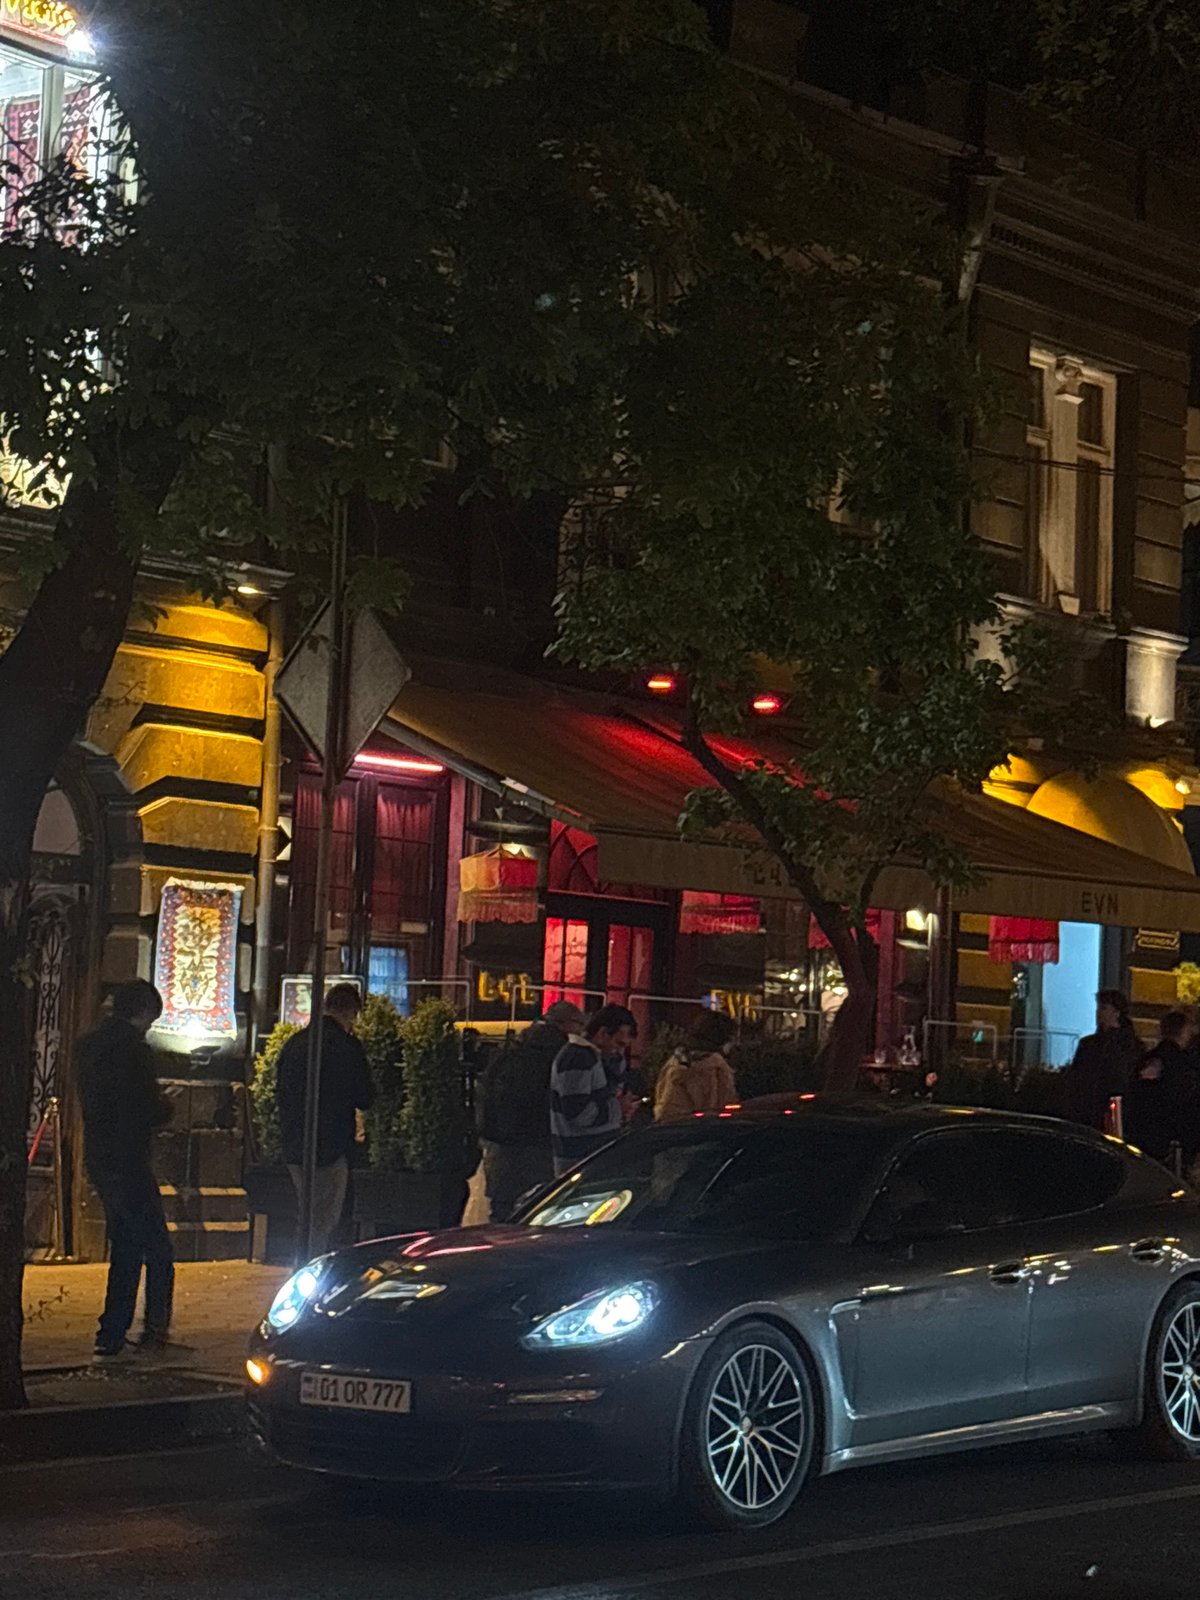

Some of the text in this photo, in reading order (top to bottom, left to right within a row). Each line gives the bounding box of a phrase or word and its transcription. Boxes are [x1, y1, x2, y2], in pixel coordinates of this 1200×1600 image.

[1081, 891, 1118, 915] EVN
[320, 1378, 405, 1409] 01 OR 777
